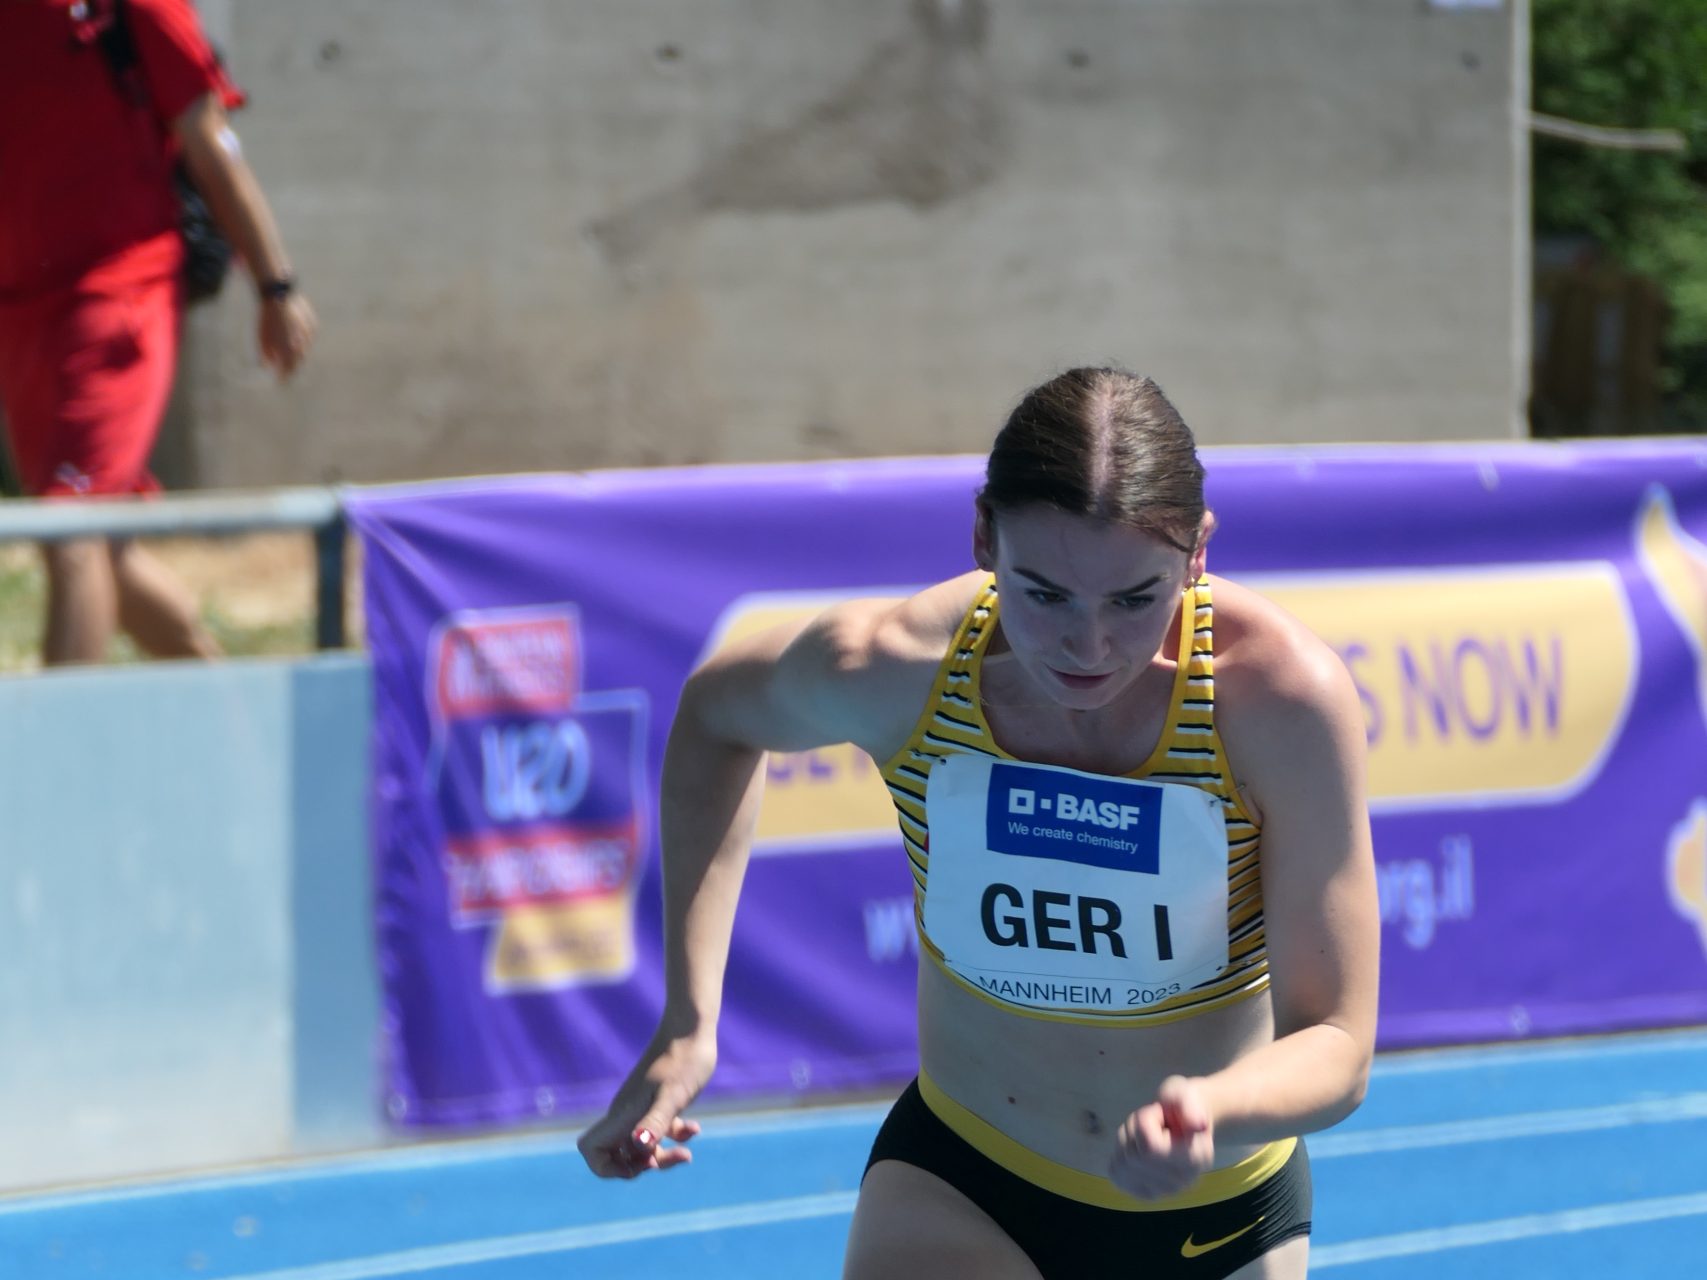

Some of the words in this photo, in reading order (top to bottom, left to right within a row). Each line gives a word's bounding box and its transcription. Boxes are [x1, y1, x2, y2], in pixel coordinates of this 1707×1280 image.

[1398, 638, 1564, 749] NOW
[1056, 793, 1140, 830] BASF
[1008, 822, 1030, 835] We
[1032, 825, 1074, 841] create
[1077, 831, 1139, 854] chemistry
[981, 883, 1129, 959] GER
[1154, 904, 1173, 961] I
[979, 976, 1112, 1004] MANNHEIM
[1127, 983, 1181, 1005] 2023
